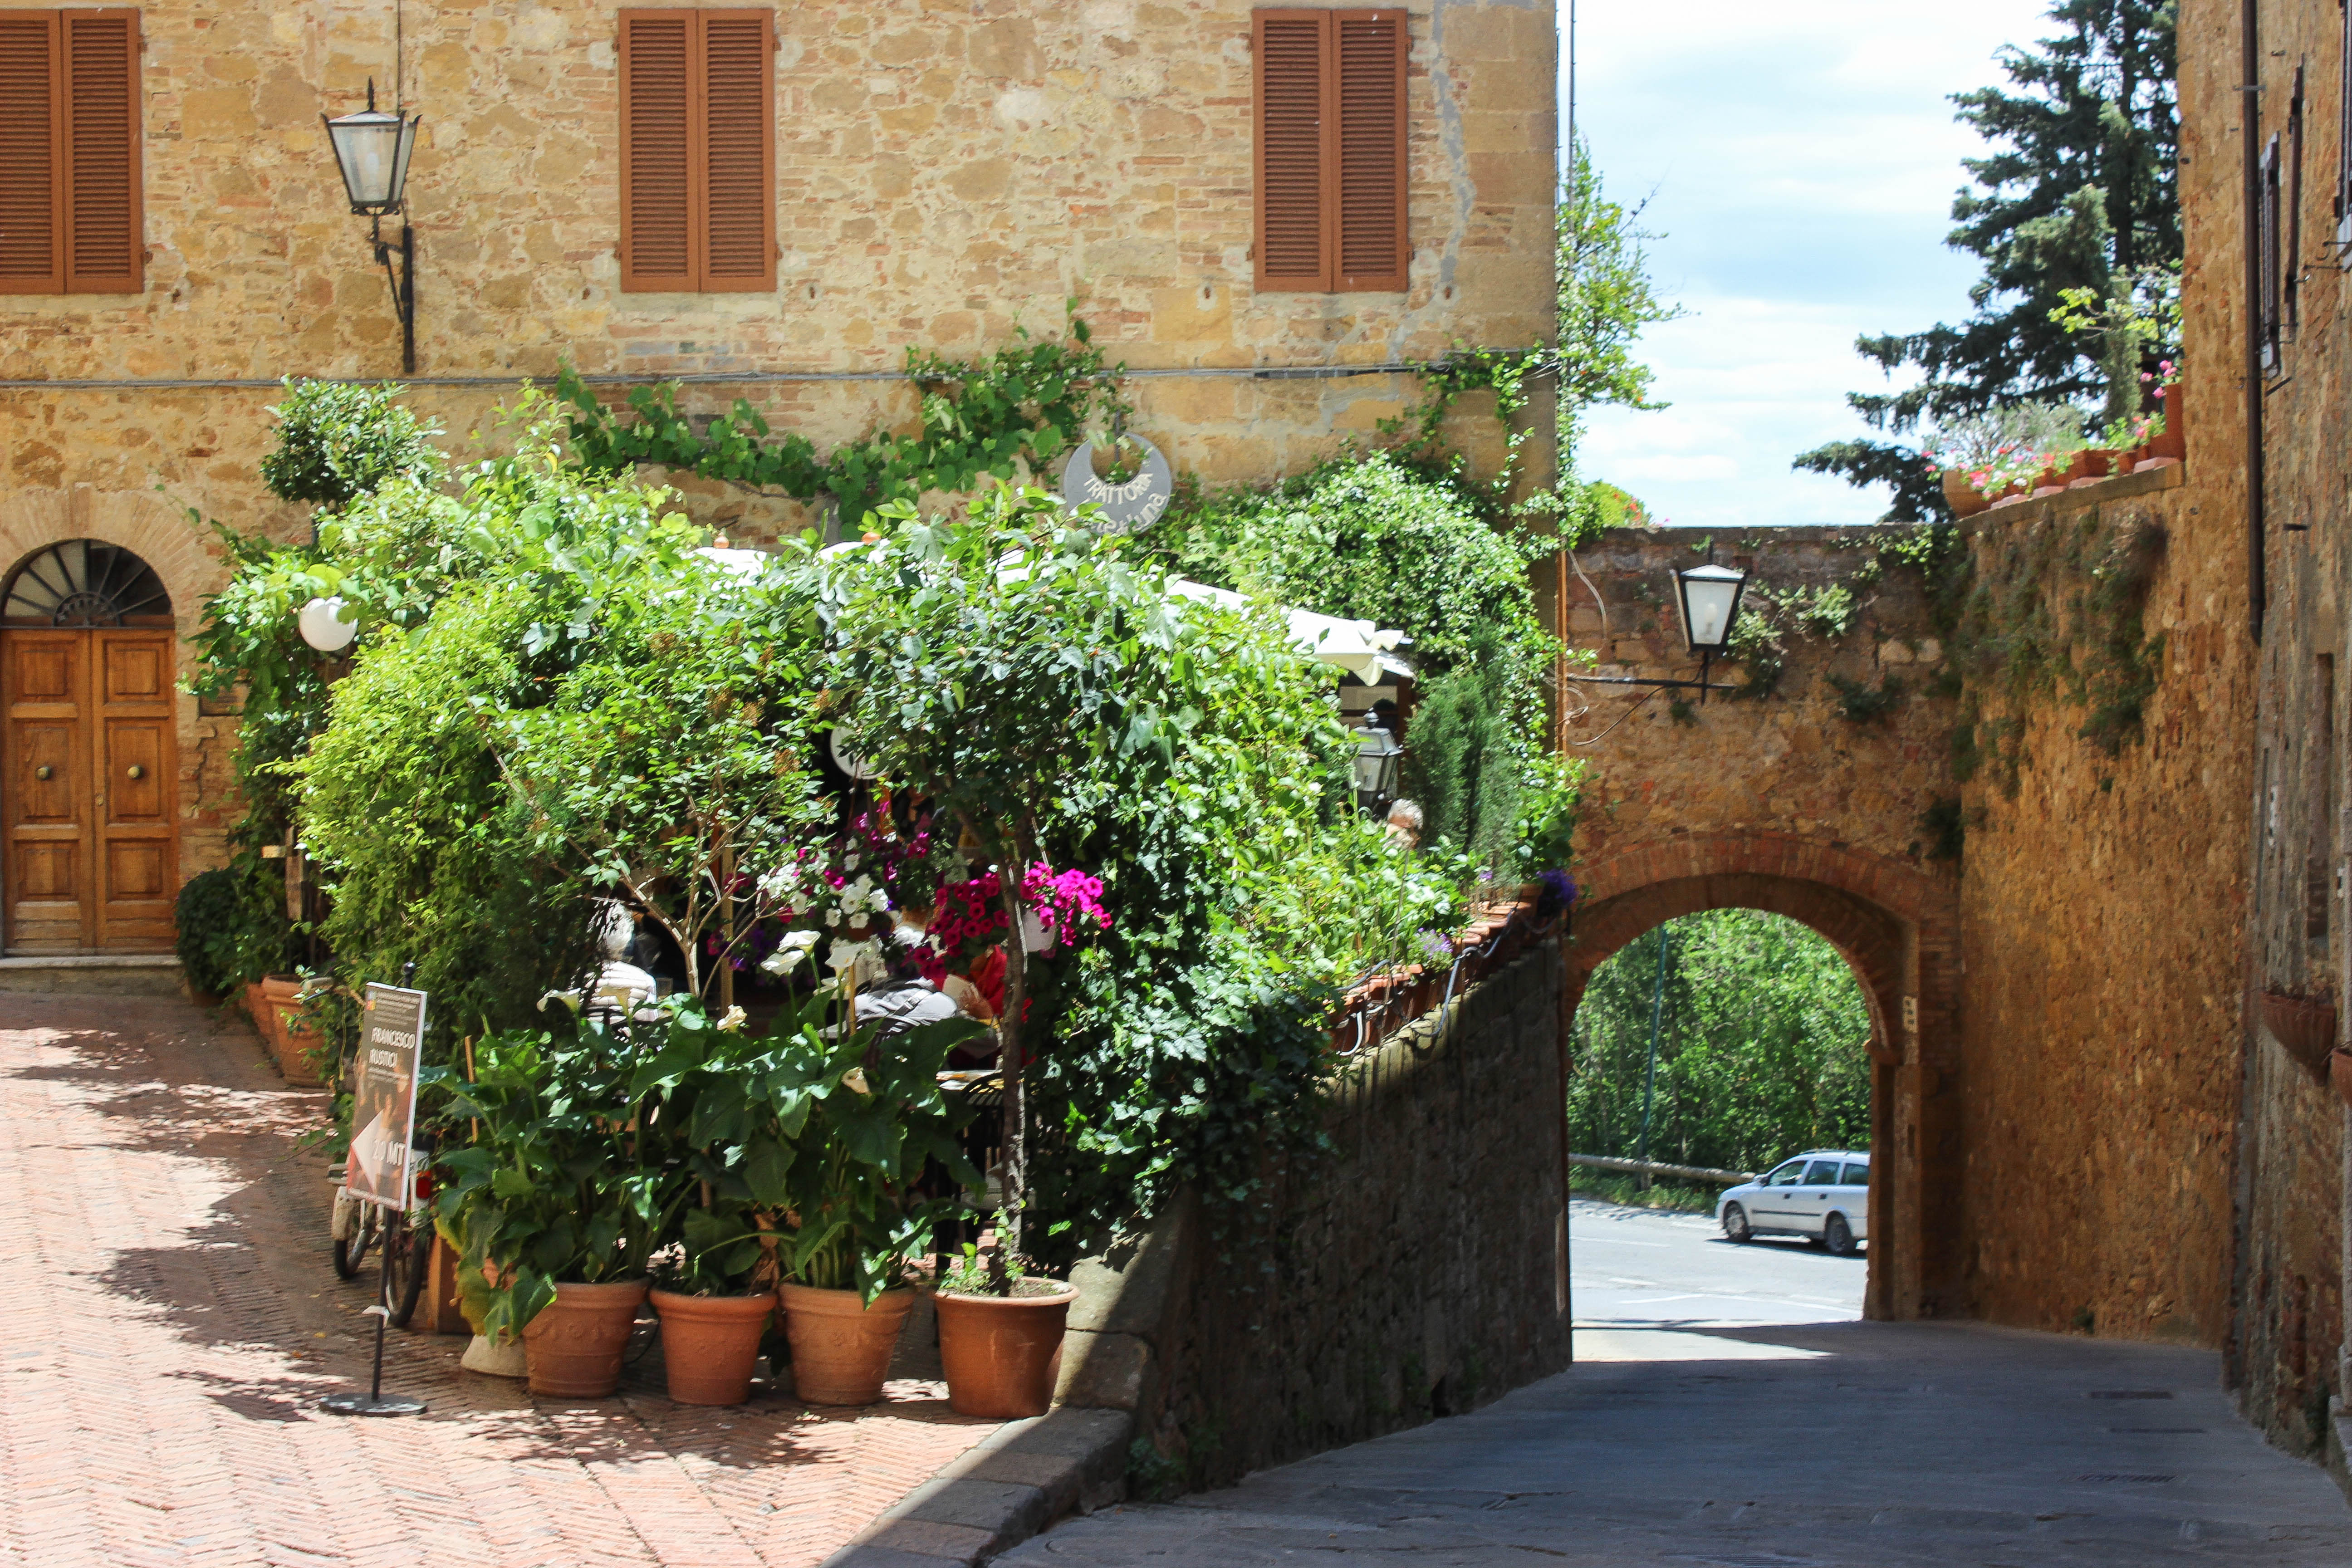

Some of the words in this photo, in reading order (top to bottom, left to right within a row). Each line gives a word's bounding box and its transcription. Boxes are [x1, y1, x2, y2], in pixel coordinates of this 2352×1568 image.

[371, 1026, 416, 1049] FRANCESCO
[369, 1048, 398, 1068] RUSTICI
[387, 1140, 407, 1166] MT
